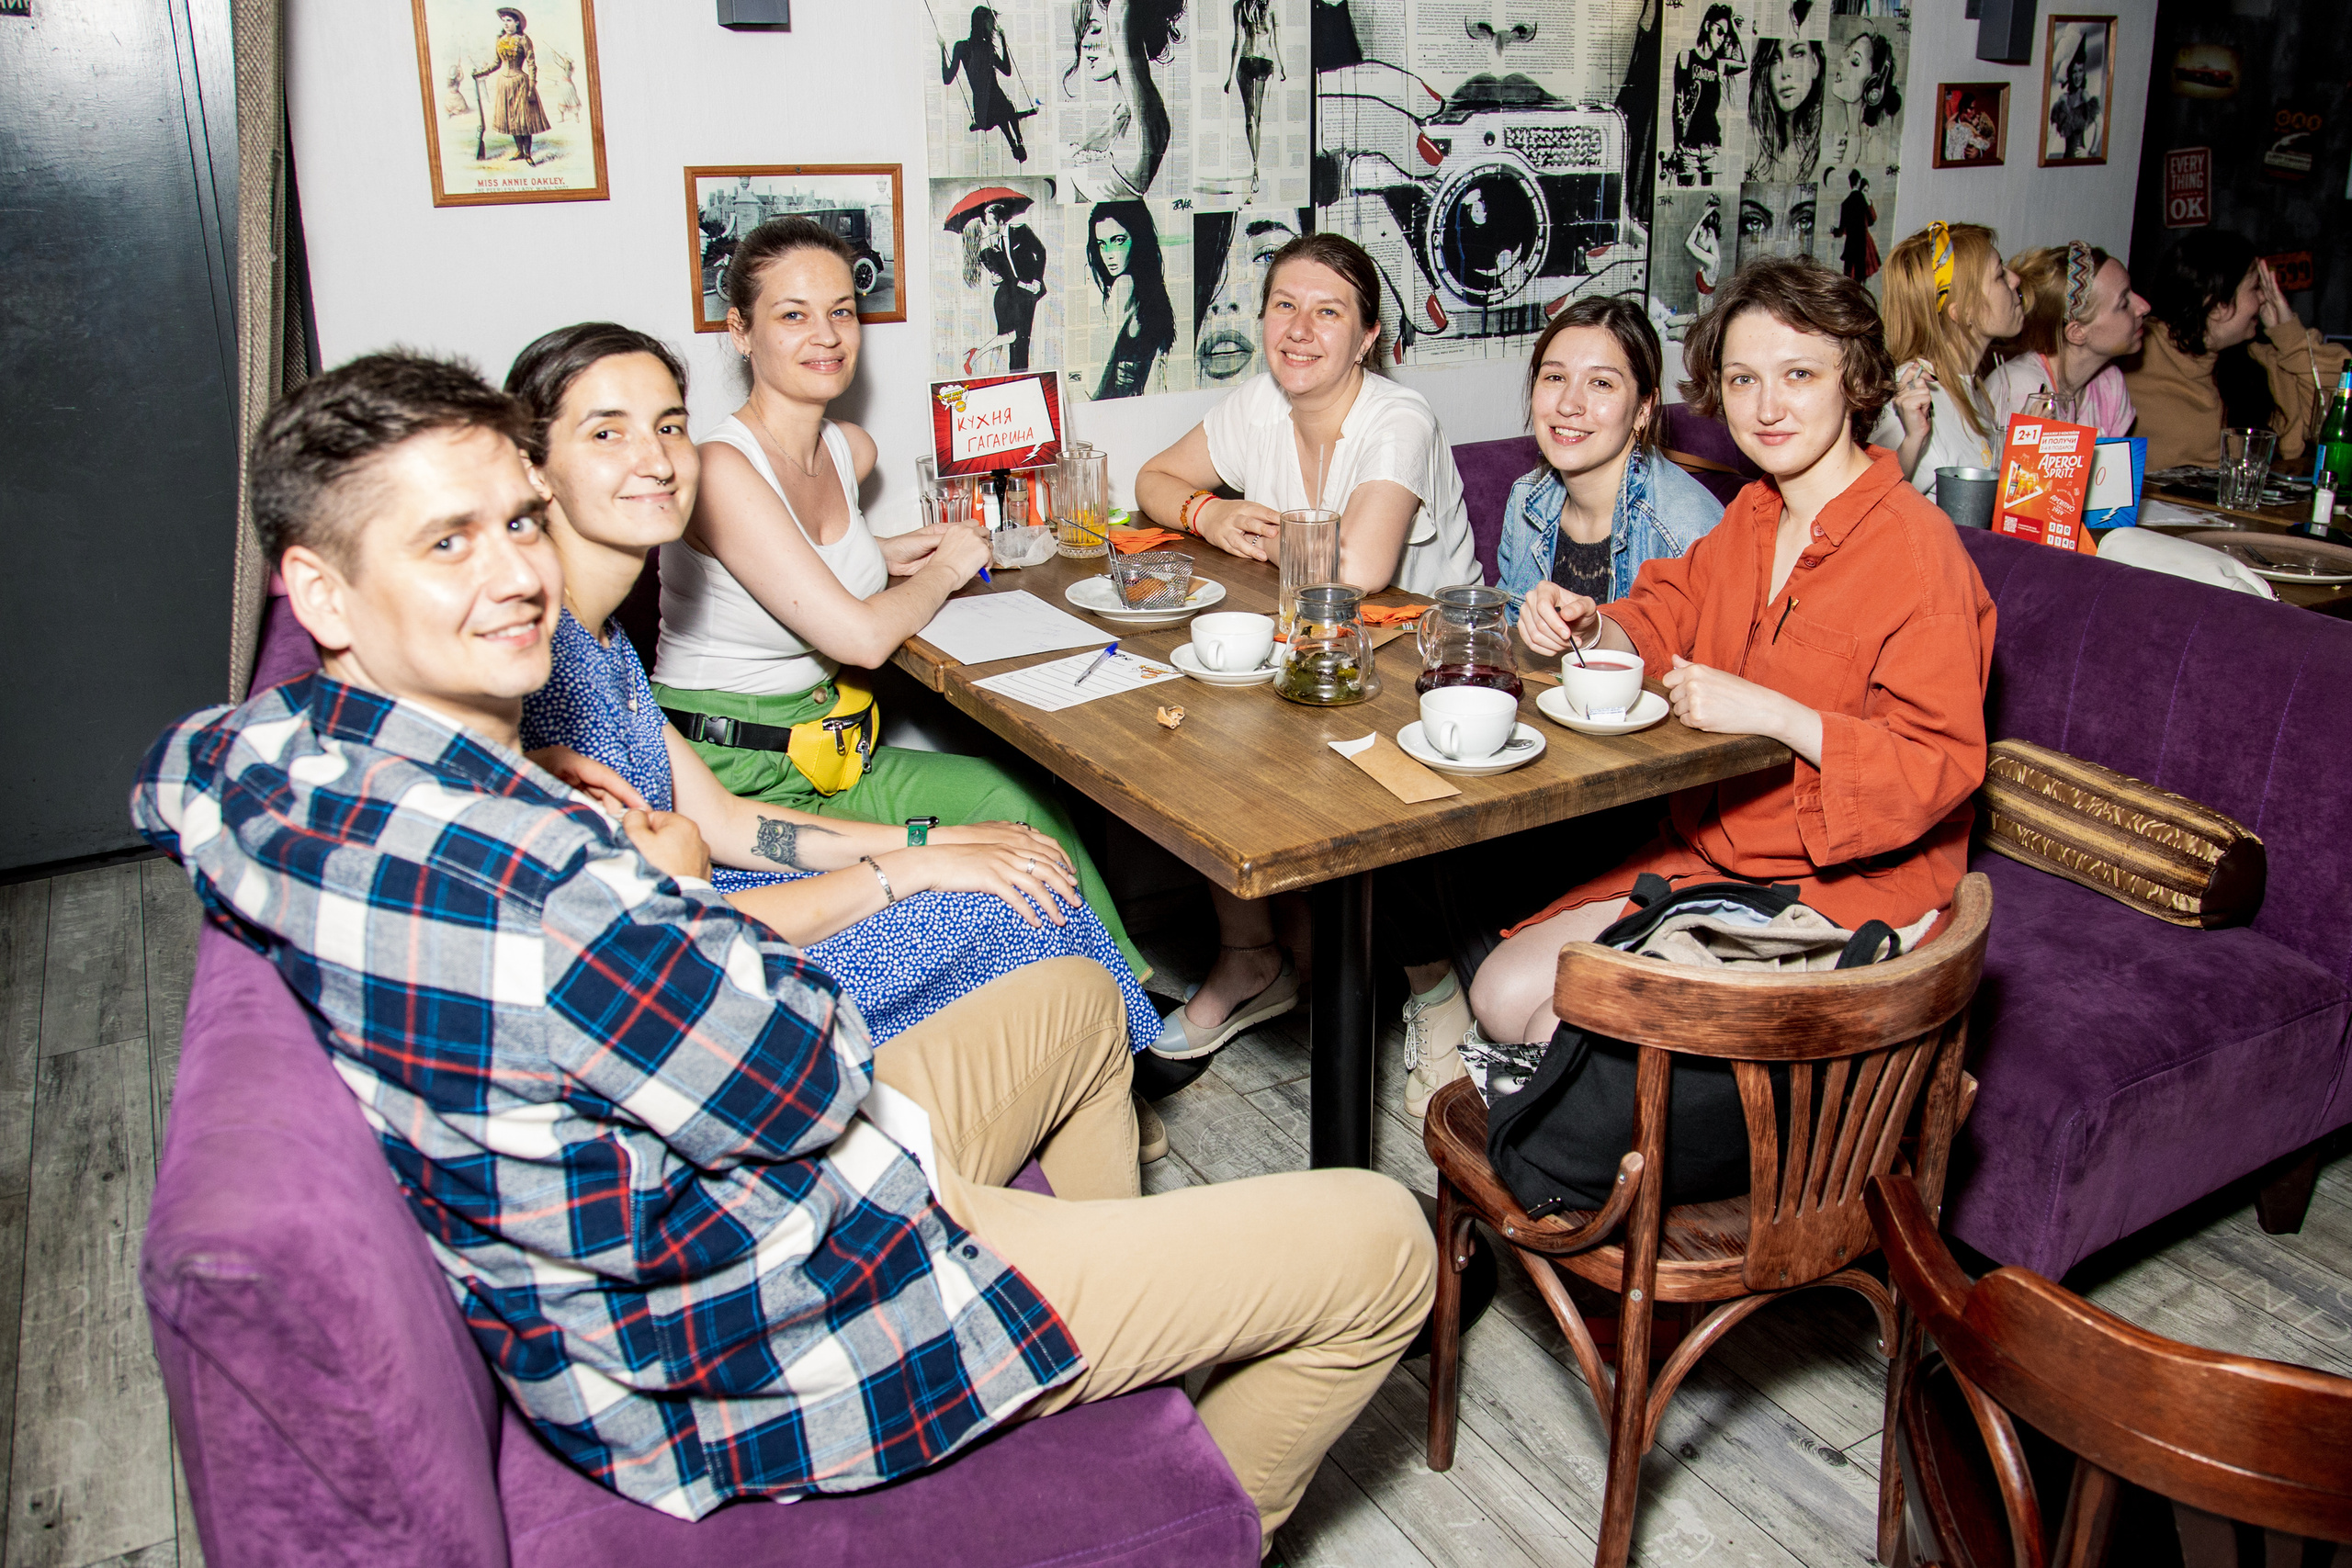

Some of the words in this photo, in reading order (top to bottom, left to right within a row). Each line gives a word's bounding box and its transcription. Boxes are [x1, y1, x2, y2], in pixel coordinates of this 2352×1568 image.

[2170, 153, 2205, 174] EVERY
[477, 179, 499, 187] MISS
[502, 178, 528, 186] ANNIE
[531, 177, 565, 186] OAKLEY.
[2171, 173, 2204, 190] THING
[2170, 197, 2205, 220] OK
[957, 407, 1012, 432] КУХНЯ
[967, 426, 1035, 453] ГАГАРИНА
[2018, 429, 2038, 441] 2+1
[2038, 454, 2083, 470] APEROL
[2049, 494, 2075, 513] APERITIVO
